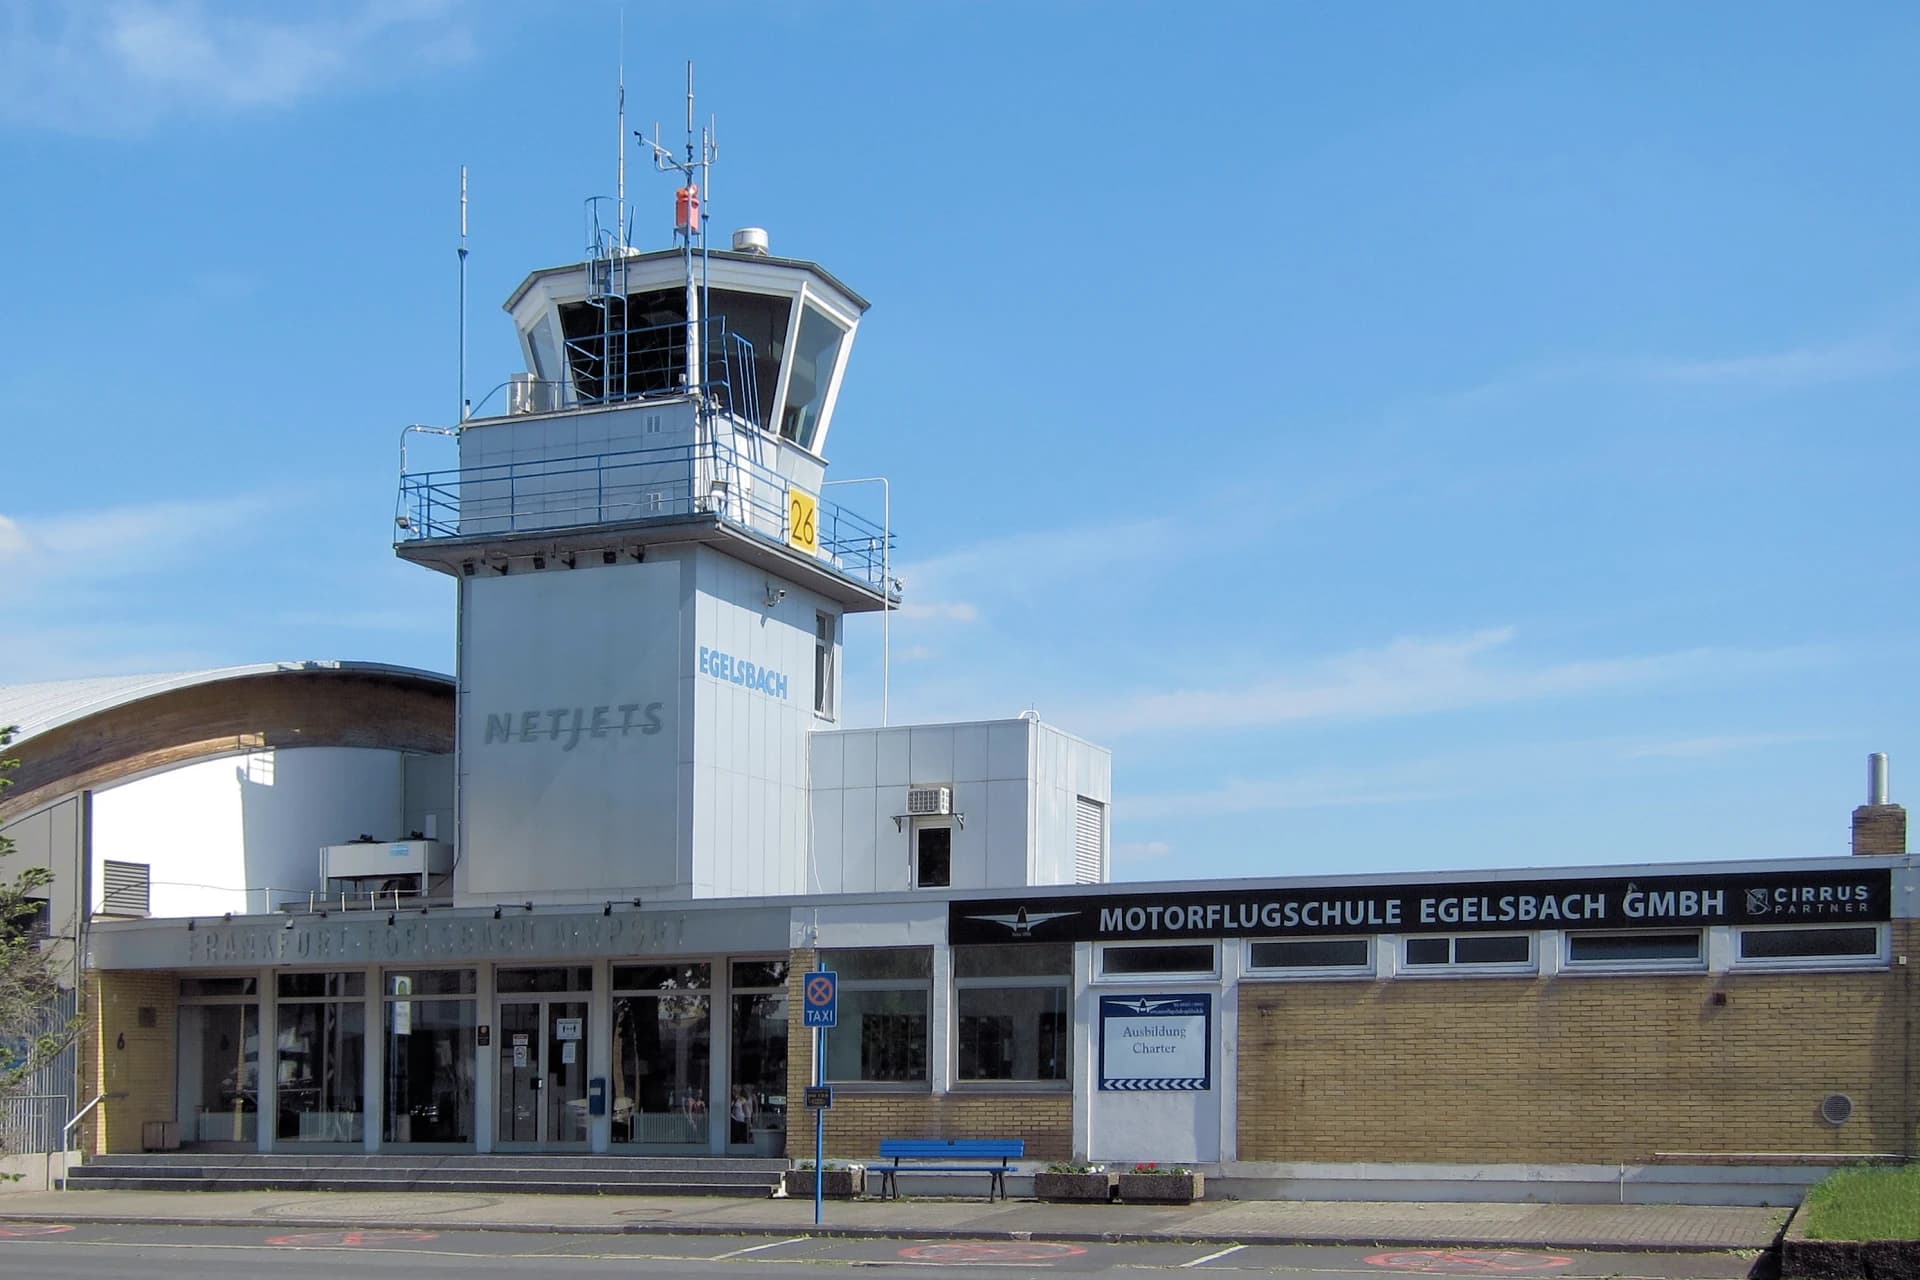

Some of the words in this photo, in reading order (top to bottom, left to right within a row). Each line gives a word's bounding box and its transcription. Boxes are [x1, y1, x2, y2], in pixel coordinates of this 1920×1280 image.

[790, 499, 815, 546] 26
[699, 646, 788, 700] EGELSBACH
[483, 702, 664, 752] NETJETS
[1774, 885, 1869, 902] CIRRUS
[1099, 899, 1402, 932] MOTORFLUGSCHULE
[1420, 892, 1606, 924] EGELSBACH
[1622, 889, 1724, 919] GMBH
[1774, 902, 1868, 915] PARTNER
[807, 1009, 833, 1022] TAXI
[1122, 1025, 1187, 1039] Ausbildung
[1132, 1042, 1177, 1054] Charter
